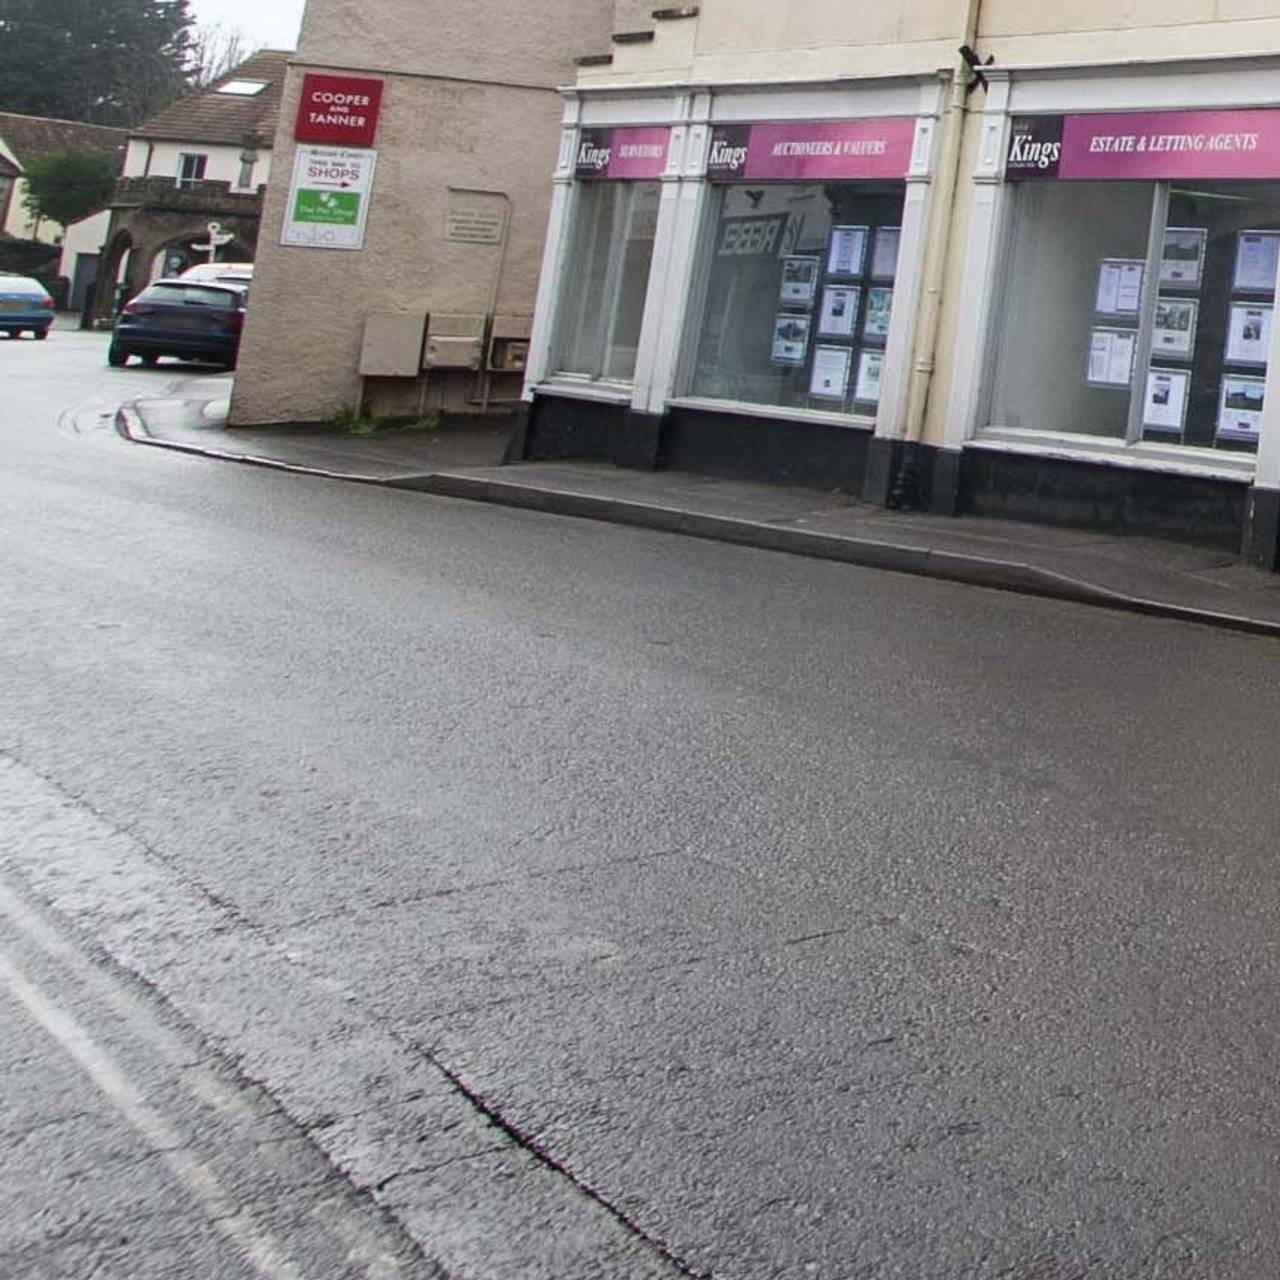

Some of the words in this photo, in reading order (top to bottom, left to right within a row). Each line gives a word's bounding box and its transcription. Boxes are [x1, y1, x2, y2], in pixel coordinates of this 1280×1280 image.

[311, 91, 370, 107] COOPER
[329, 105, 350, 113] AND
[308, 112, 366, 128] TANNER
[1009, 134, 1061, 169] Kings
[1089, 136, 1134, 153] ESTATE
[1136, 136, 1146, 152] &
[1147, 134, 1203, 152] LETTING
[1204, 133, 1259, 151] AGENTS
[578, 142, 611, 170] Kings
[709, 140, 748, 170] Kings
[307, 165, 360, 181] SHOPS
